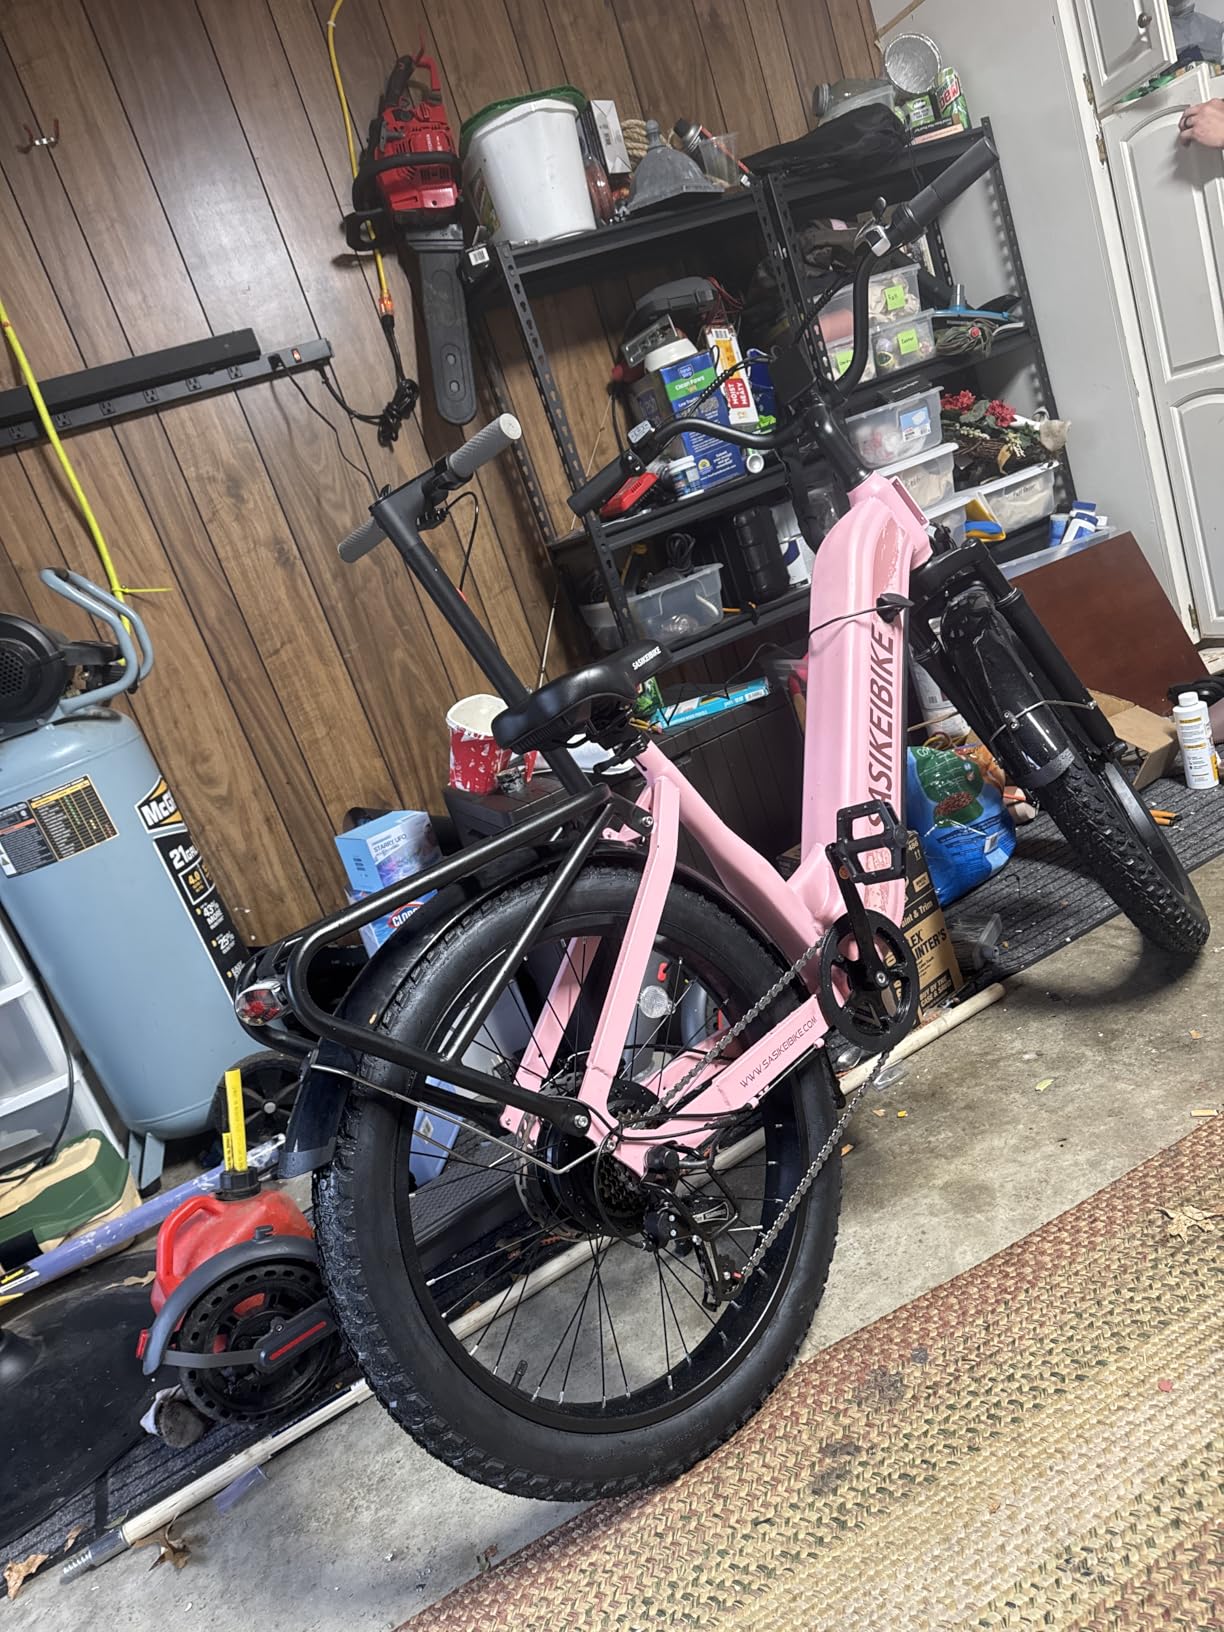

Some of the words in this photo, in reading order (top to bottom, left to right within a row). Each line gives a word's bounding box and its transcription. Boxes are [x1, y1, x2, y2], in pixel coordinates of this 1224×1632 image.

[728, 383, 738, 405] MOIST
[736, 382, 748, 406] MEATY
[140, 790, 176, 826] McG
[902, 913, 913, 927] aint
[913, 910, 919, 918] &
[918, 901, 933, 914] Trim
[910, 930, 924, 947] EX
[913, 928, 946, 959] INTER'S
